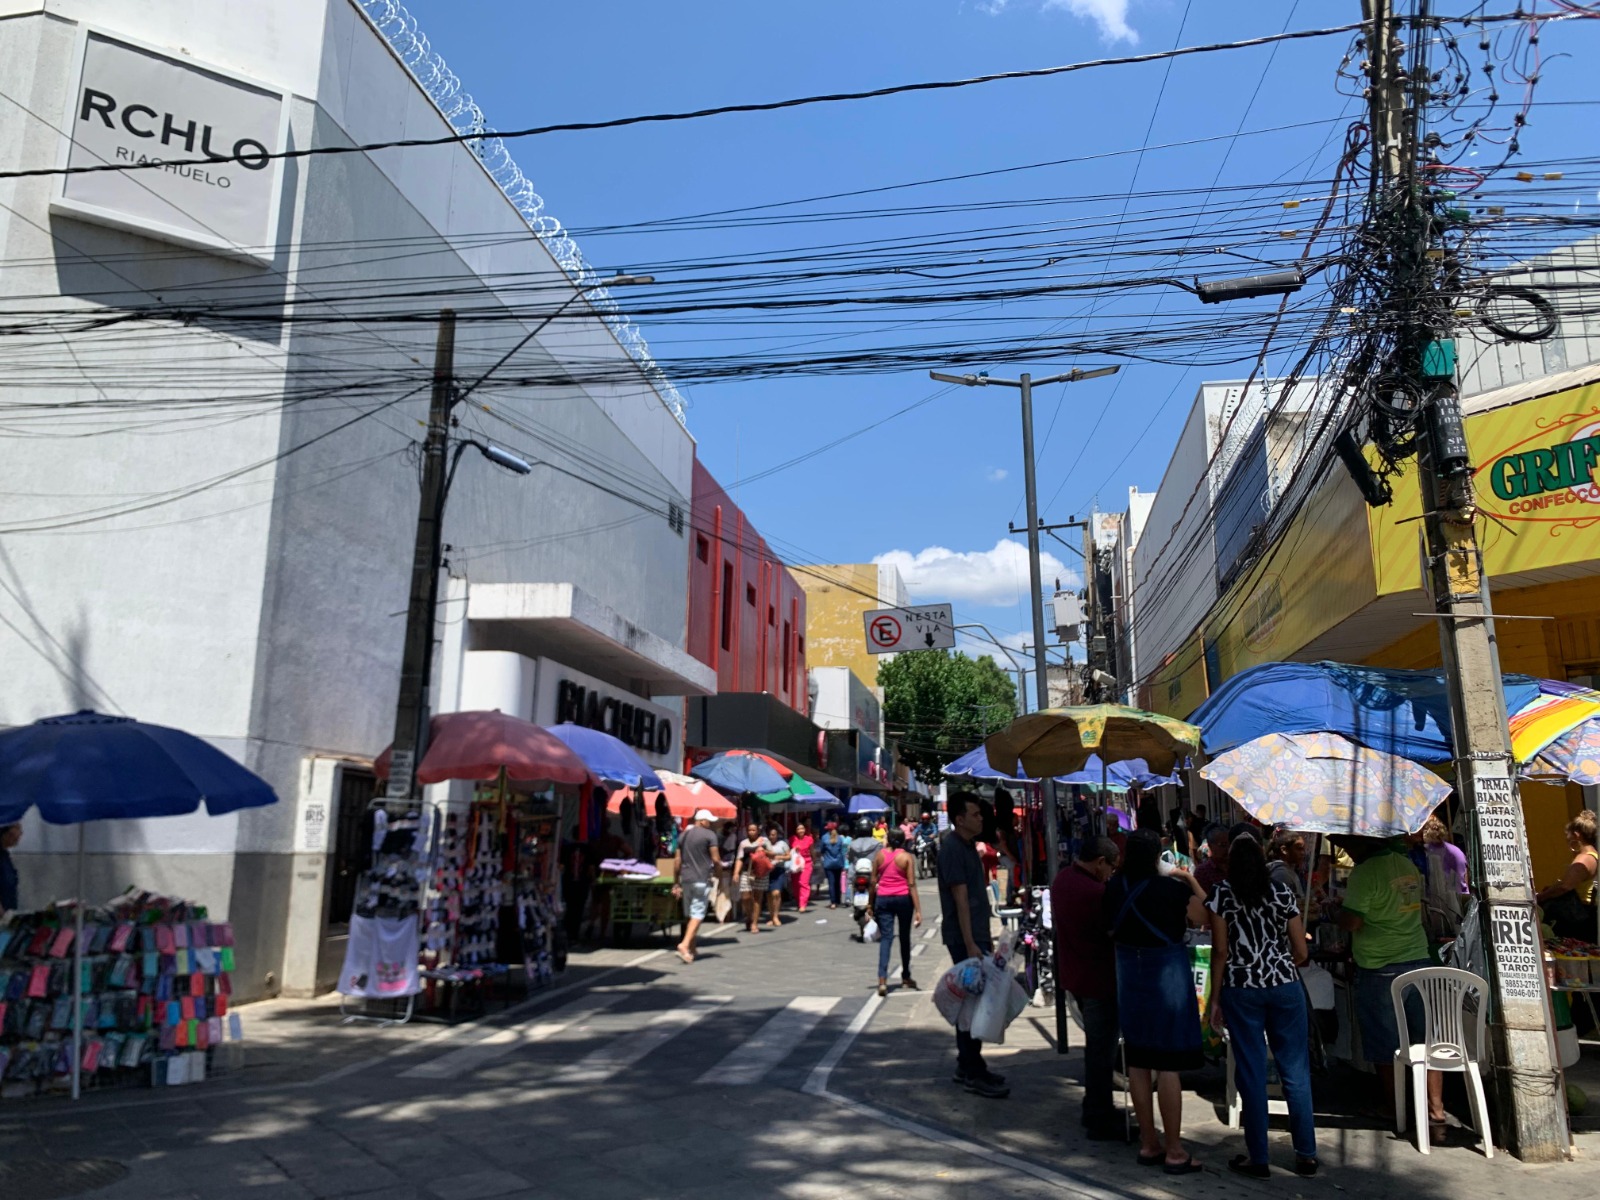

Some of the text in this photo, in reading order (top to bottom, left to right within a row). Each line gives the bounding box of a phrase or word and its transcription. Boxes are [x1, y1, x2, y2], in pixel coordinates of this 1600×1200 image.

[80, 87, 270, 170] RCHLO
[116, 146, 231, 188] RIACHUELO
[905, 610, 947, 622] NESTA
[916, 624, 942, 633] VIA
[1477, 806, 1516, 816] CARTAS
[1480, 816, 1517, 828] BÚZIOS
[1492, 920, 1534, 946] IRIS
[1496, 945, 1536, 955] CARTAS
[1498, 953, 1537, 963] BÚZIOS
[1502, 963, 1536, 972] TAROT
